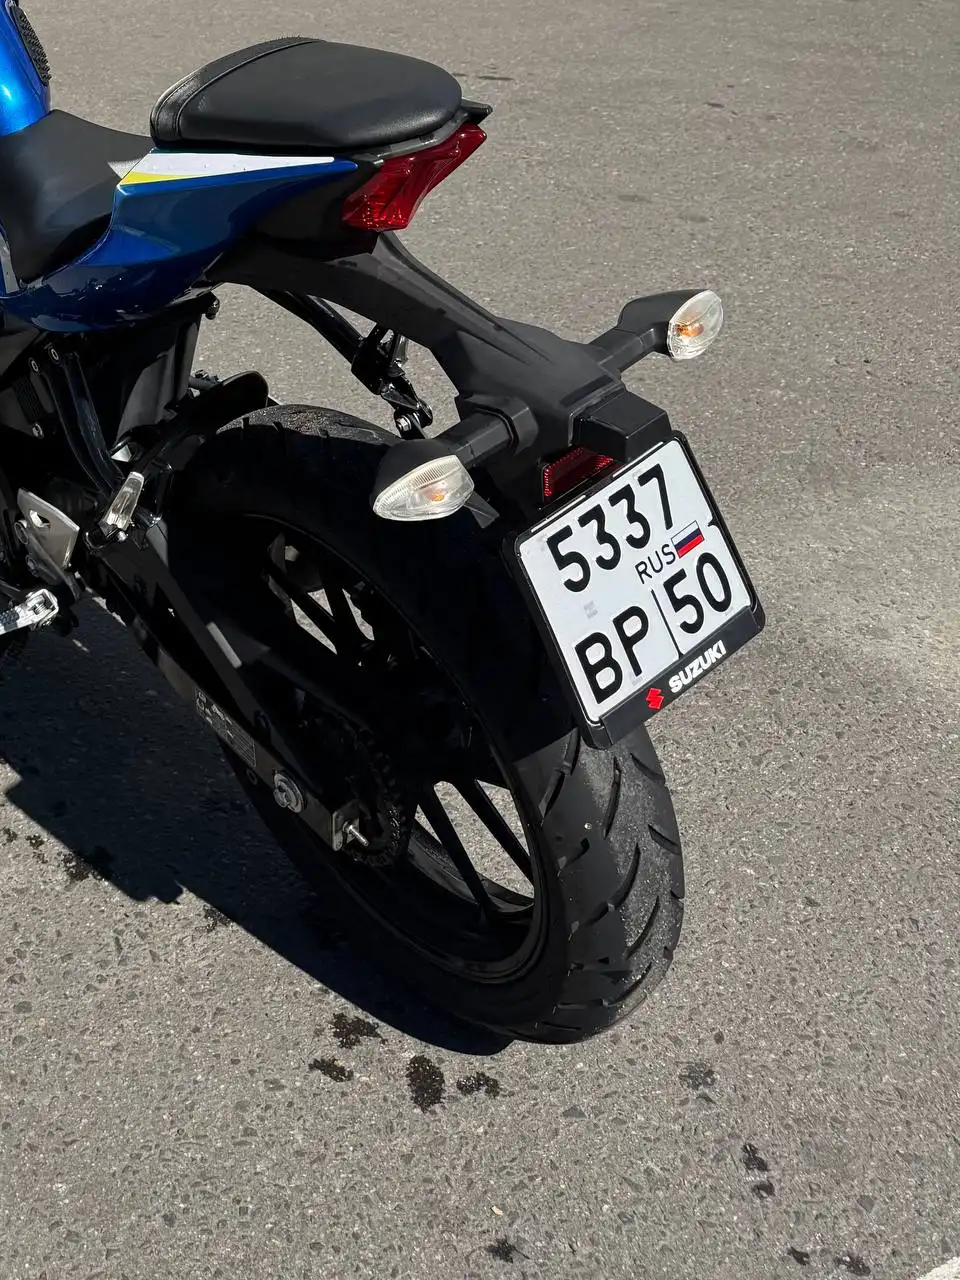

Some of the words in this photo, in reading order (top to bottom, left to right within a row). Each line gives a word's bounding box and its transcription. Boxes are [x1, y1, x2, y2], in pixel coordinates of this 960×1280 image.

[546, 462, 673, 593] 5337
[634, 543, 677, 585] RUS
[662, 552, 733, 635] 50
[668, 640, 727, 694] SUZUKI
